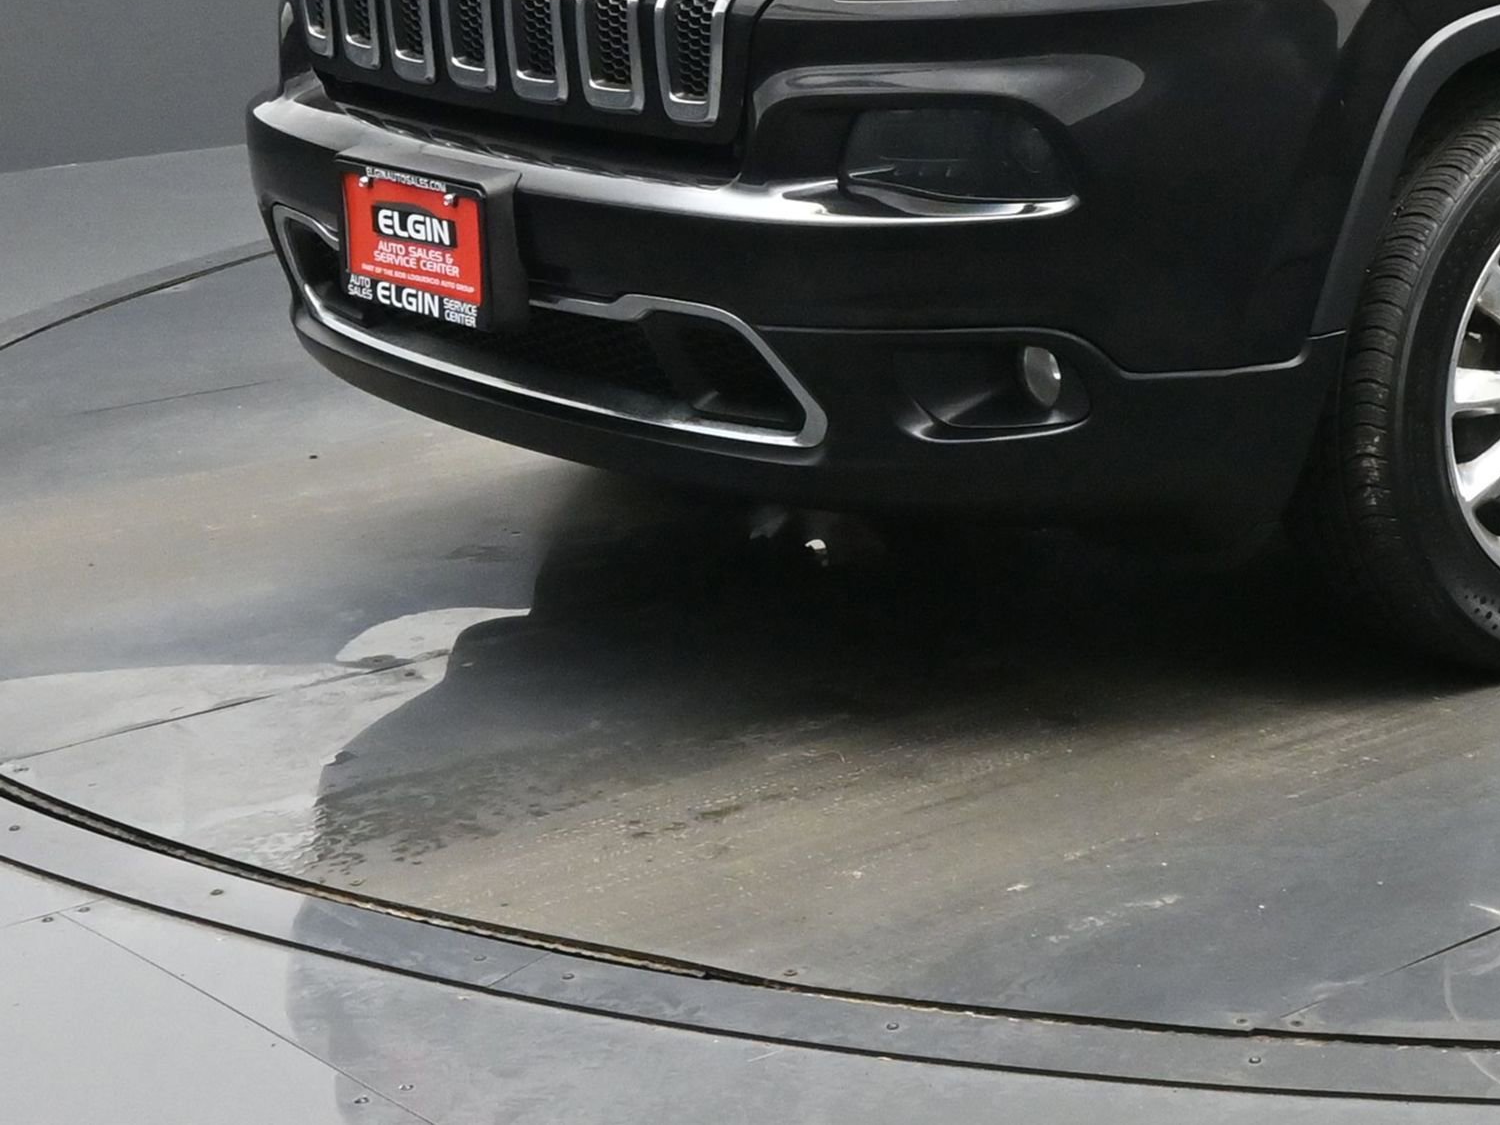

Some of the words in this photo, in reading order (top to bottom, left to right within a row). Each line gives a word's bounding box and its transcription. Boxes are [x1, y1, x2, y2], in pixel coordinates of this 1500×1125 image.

[378, 208, 451, 246] ELGIN
[373, 250, 417, 269] SERVICE
[419, 259, 460, 277] CENTER
[378, 240, 406, 255] AUTO
[408, 246, 443, 263] SALES
[445, 253, 454, 264] &
[347, 284, 373, 301] SALES
[444, 310, 477, 328] CENTER
[349, 274, 371, 288] AUTO
[377, 281, 440, 318] ELGIN
[442, 298, 477, 317] SERVICE
